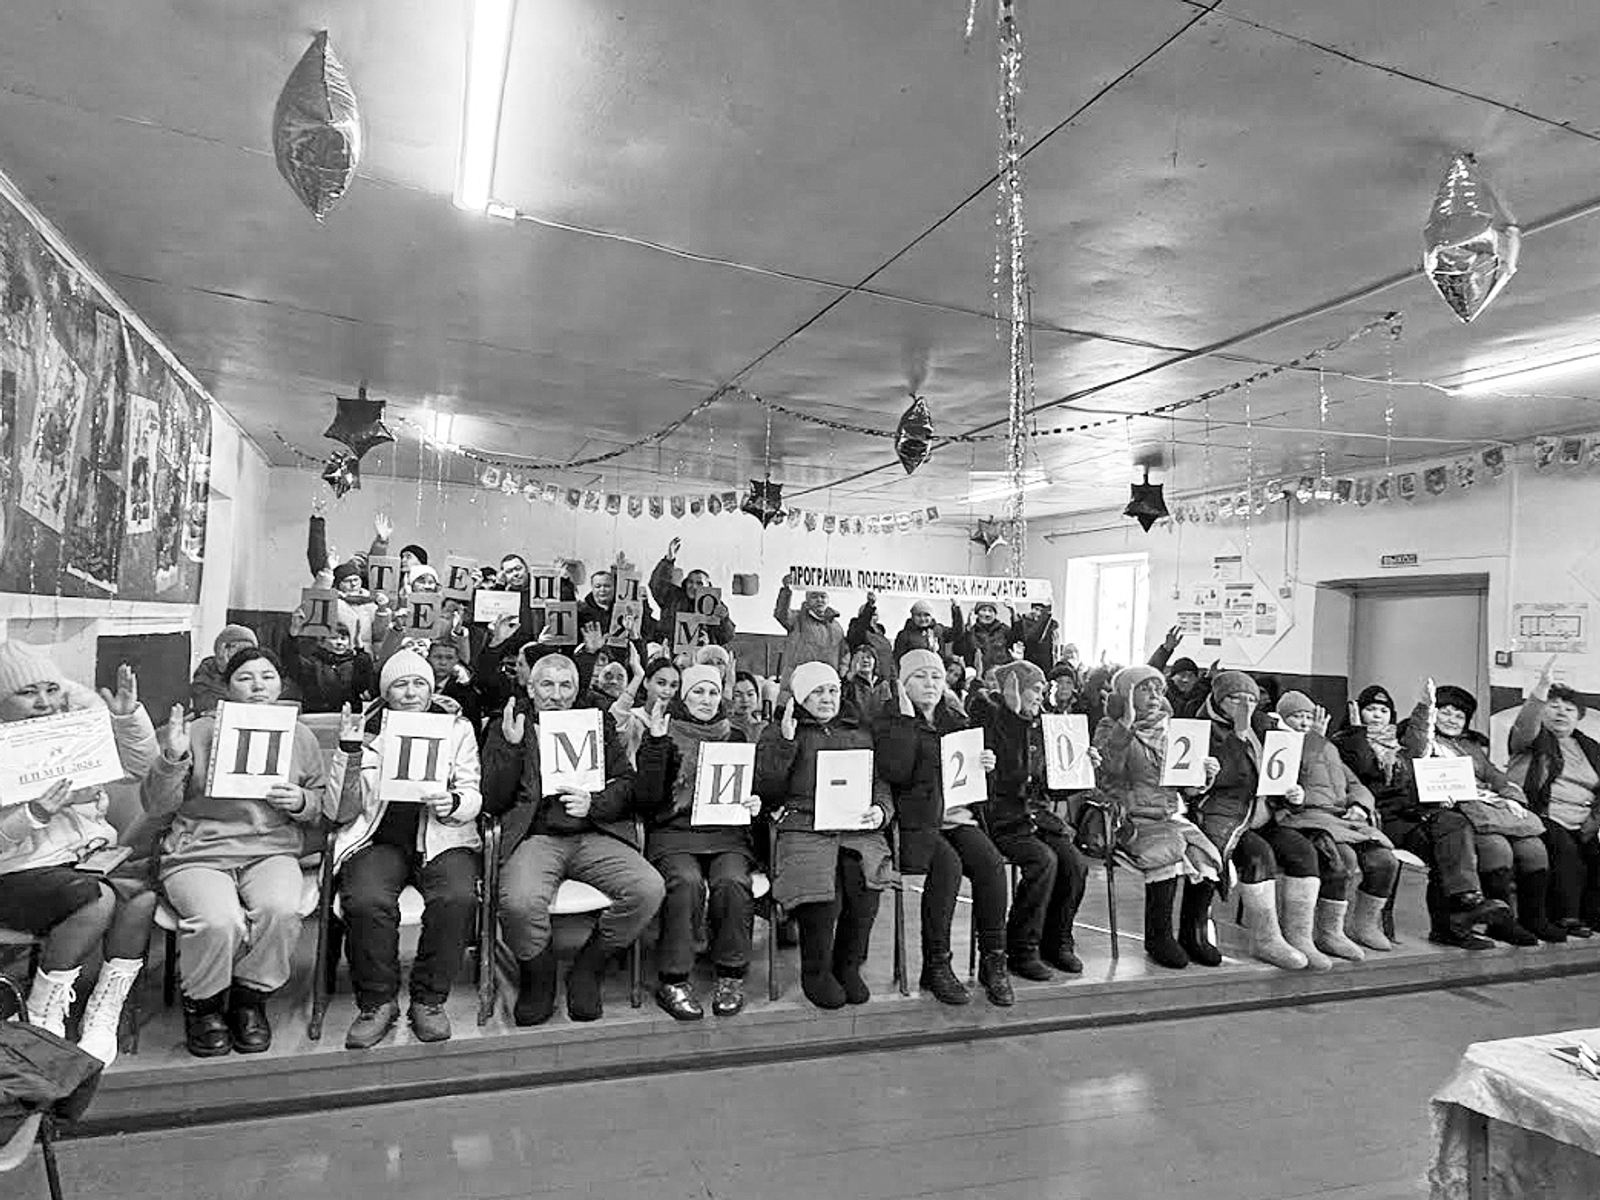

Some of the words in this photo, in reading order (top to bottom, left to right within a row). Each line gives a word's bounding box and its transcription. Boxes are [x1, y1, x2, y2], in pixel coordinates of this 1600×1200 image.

[370, 564, 393, 590] Т
[448, 566, 469, 591] Е
[533, 575, 557, 599] П
[618, 579, 639, 601] Л
[697, 593, 719, 616] О
[790, 566, 852, 588] ПРОГРАММА
[858, 570, 919, 593] ПОДДЕРЖКИ
[921, 575, 968, 595] МЕСТНЫХ
[971, 579, 1027, 600] ИНИЦИАТИВ
[303, 598, 331, 633] Д
[410, 602, 434, 630] Е
[548, 610, 572, 636] Т
[677, 620, 704, 646] М
[226, 727, 290, 776] П
[390, 735, 447, 782] П
[551, 729, 599, 775] М
[708, 763, 749, 805] И
[950, 751, 968, 789] 2
[1172, 736, 1191, 769] 2
[1266, 746, 1288, 781] 6
